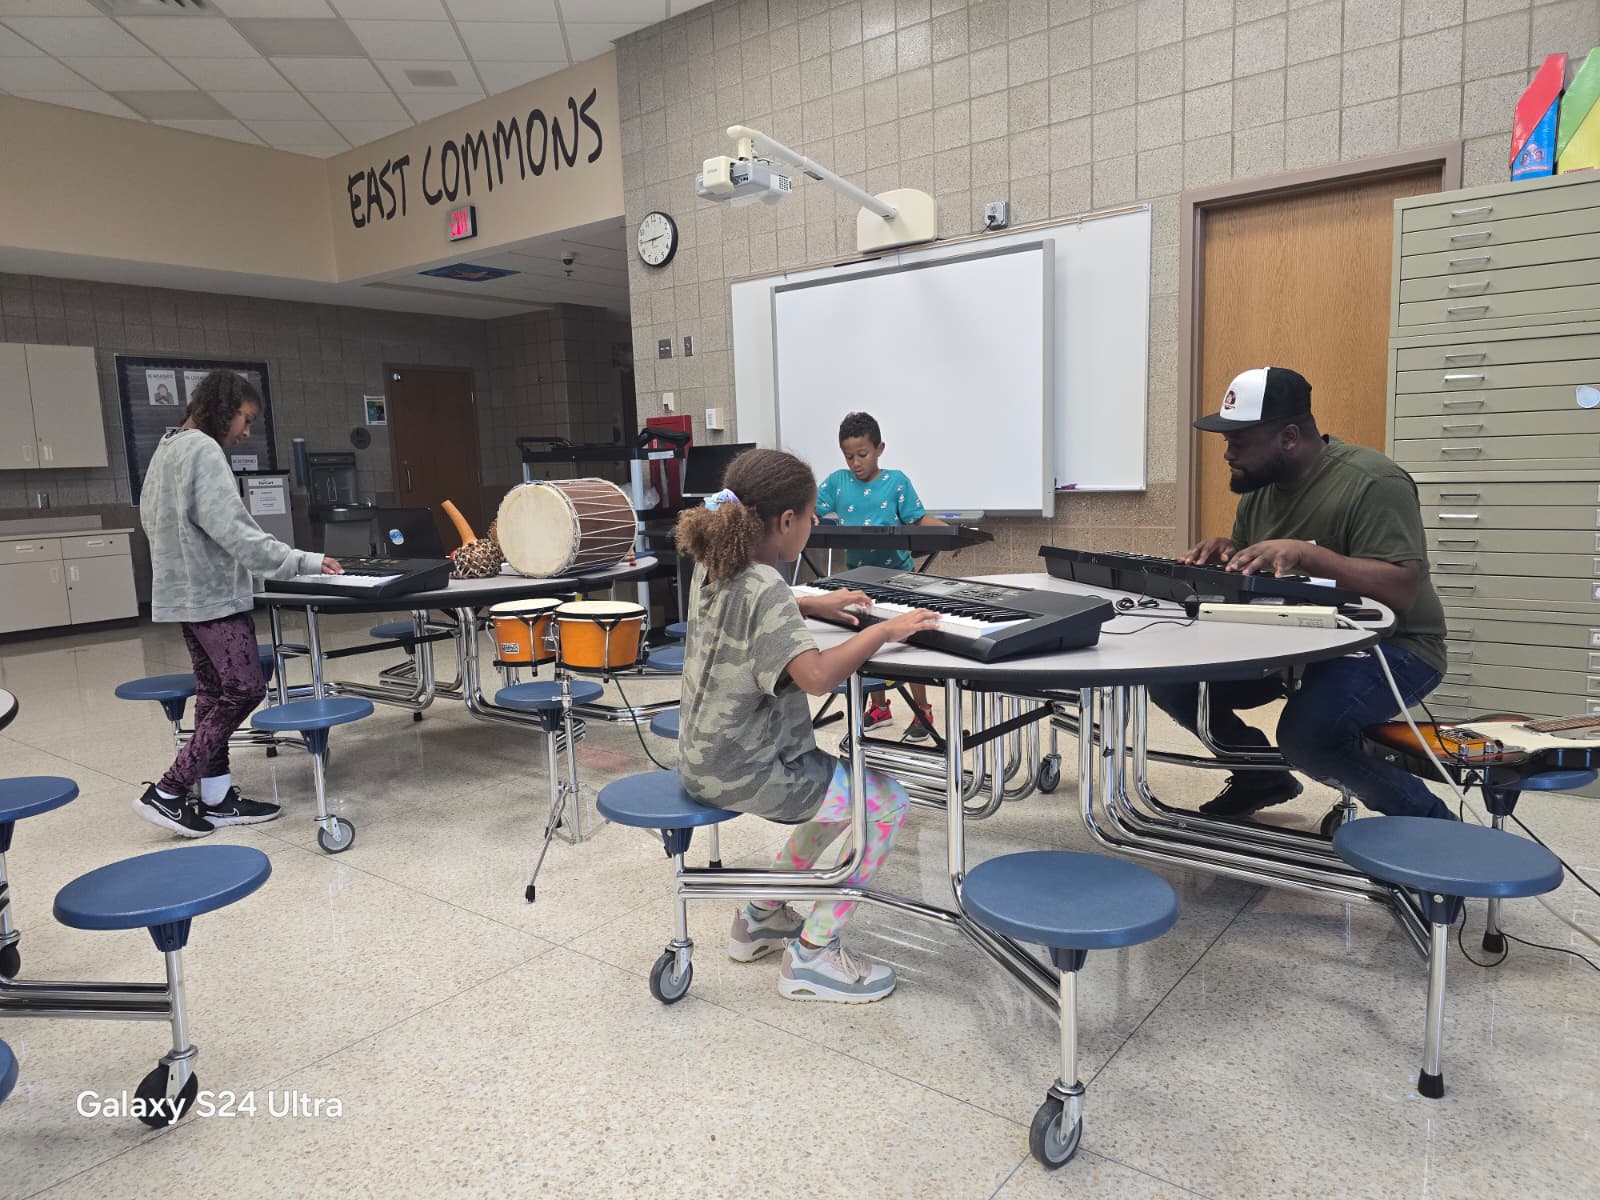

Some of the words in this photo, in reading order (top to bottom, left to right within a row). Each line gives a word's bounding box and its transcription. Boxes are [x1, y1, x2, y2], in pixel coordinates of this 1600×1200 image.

[347, 154, 410, 229] EAST
[422, 87, 603, 206] COMMONS
[450, 210, 469, 237] EXIT
